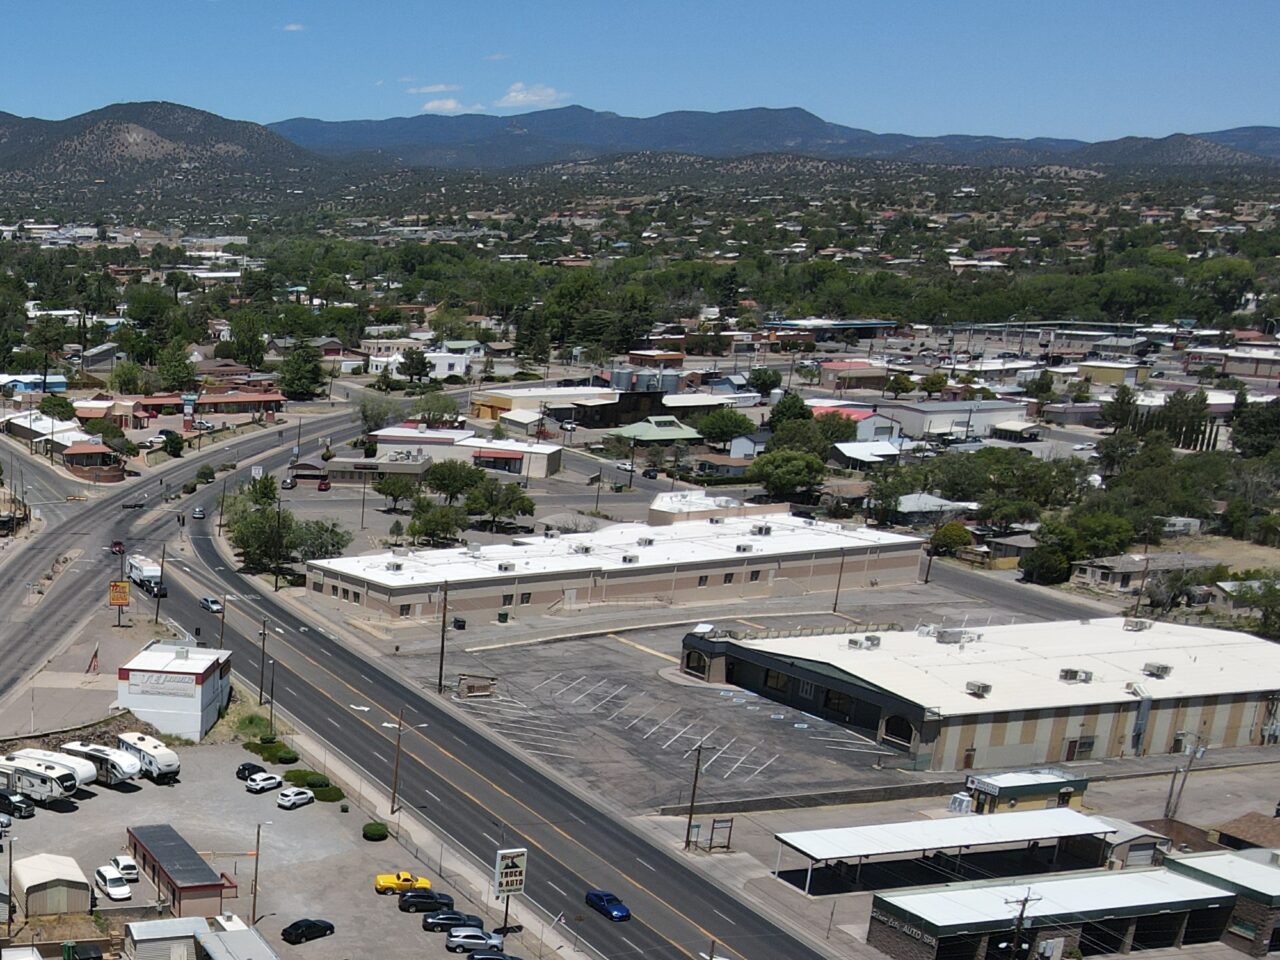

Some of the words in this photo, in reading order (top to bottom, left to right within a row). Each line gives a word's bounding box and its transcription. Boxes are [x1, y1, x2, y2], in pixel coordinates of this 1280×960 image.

[500, 870, 523, 878] TRUCK
[505, 879, 524, 887] AUTO
[903, 924, 922, 940] AUTO
[923, 934, 936, 948] SPA
